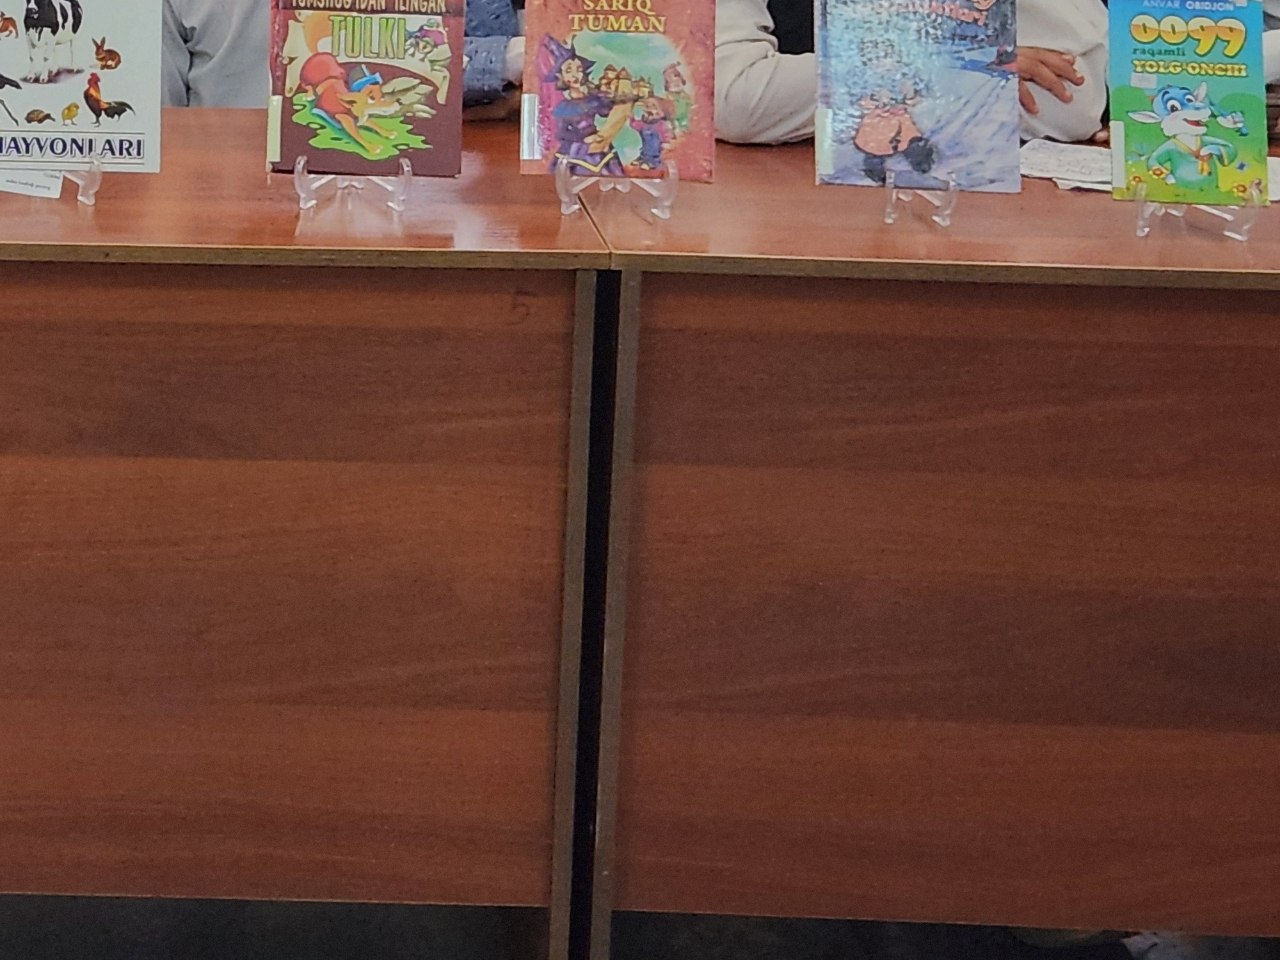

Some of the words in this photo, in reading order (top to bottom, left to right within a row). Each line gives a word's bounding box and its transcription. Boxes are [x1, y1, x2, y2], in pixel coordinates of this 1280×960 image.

[1185, 0, 1235, 12] OBIDJON
[568, 14, 667, 33] TUMAN
[328, 15, 407, 60] TULKI
[1130, 14, 1247, 58] 0099
[1132, 47, 1186, 59] raqamli
[1132, 59, 1249, 78] YOLG'ONCHI
